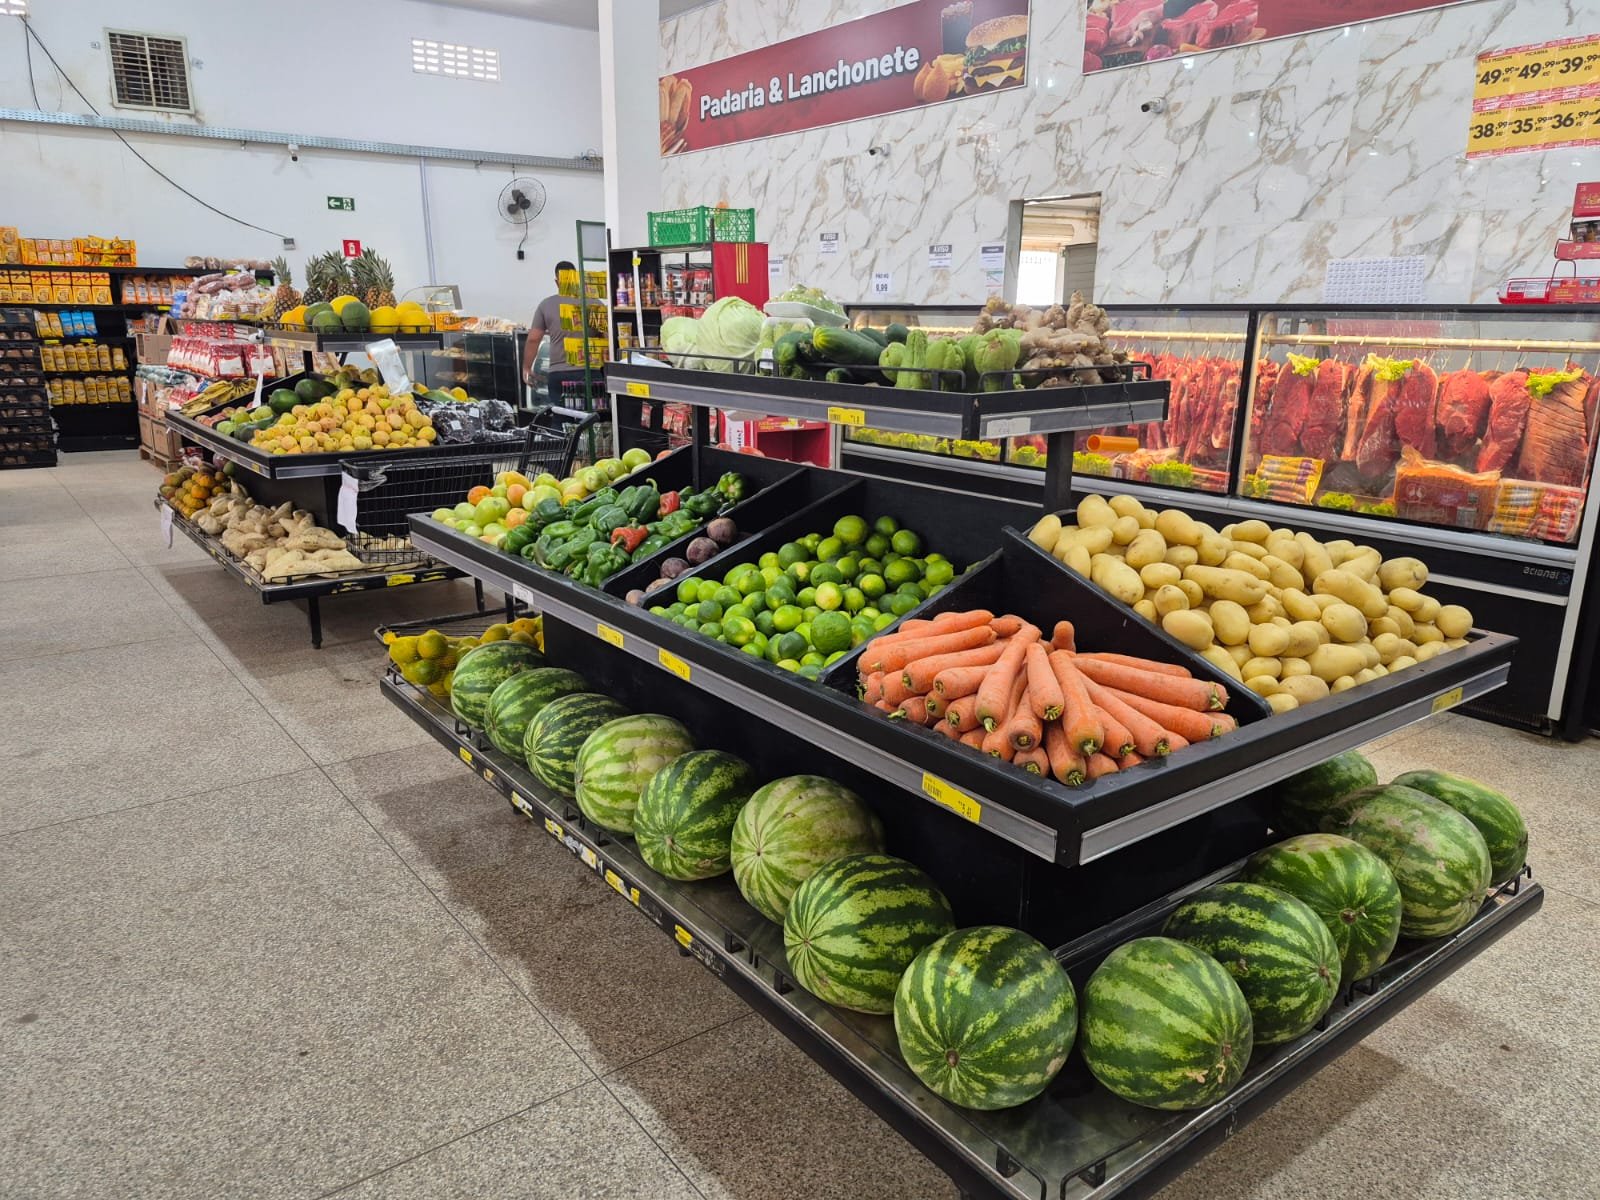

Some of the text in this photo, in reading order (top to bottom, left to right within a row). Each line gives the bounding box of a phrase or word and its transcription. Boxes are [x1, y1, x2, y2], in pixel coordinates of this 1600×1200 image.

[700, 45, 920, 120] Padaria & Lanchonete
